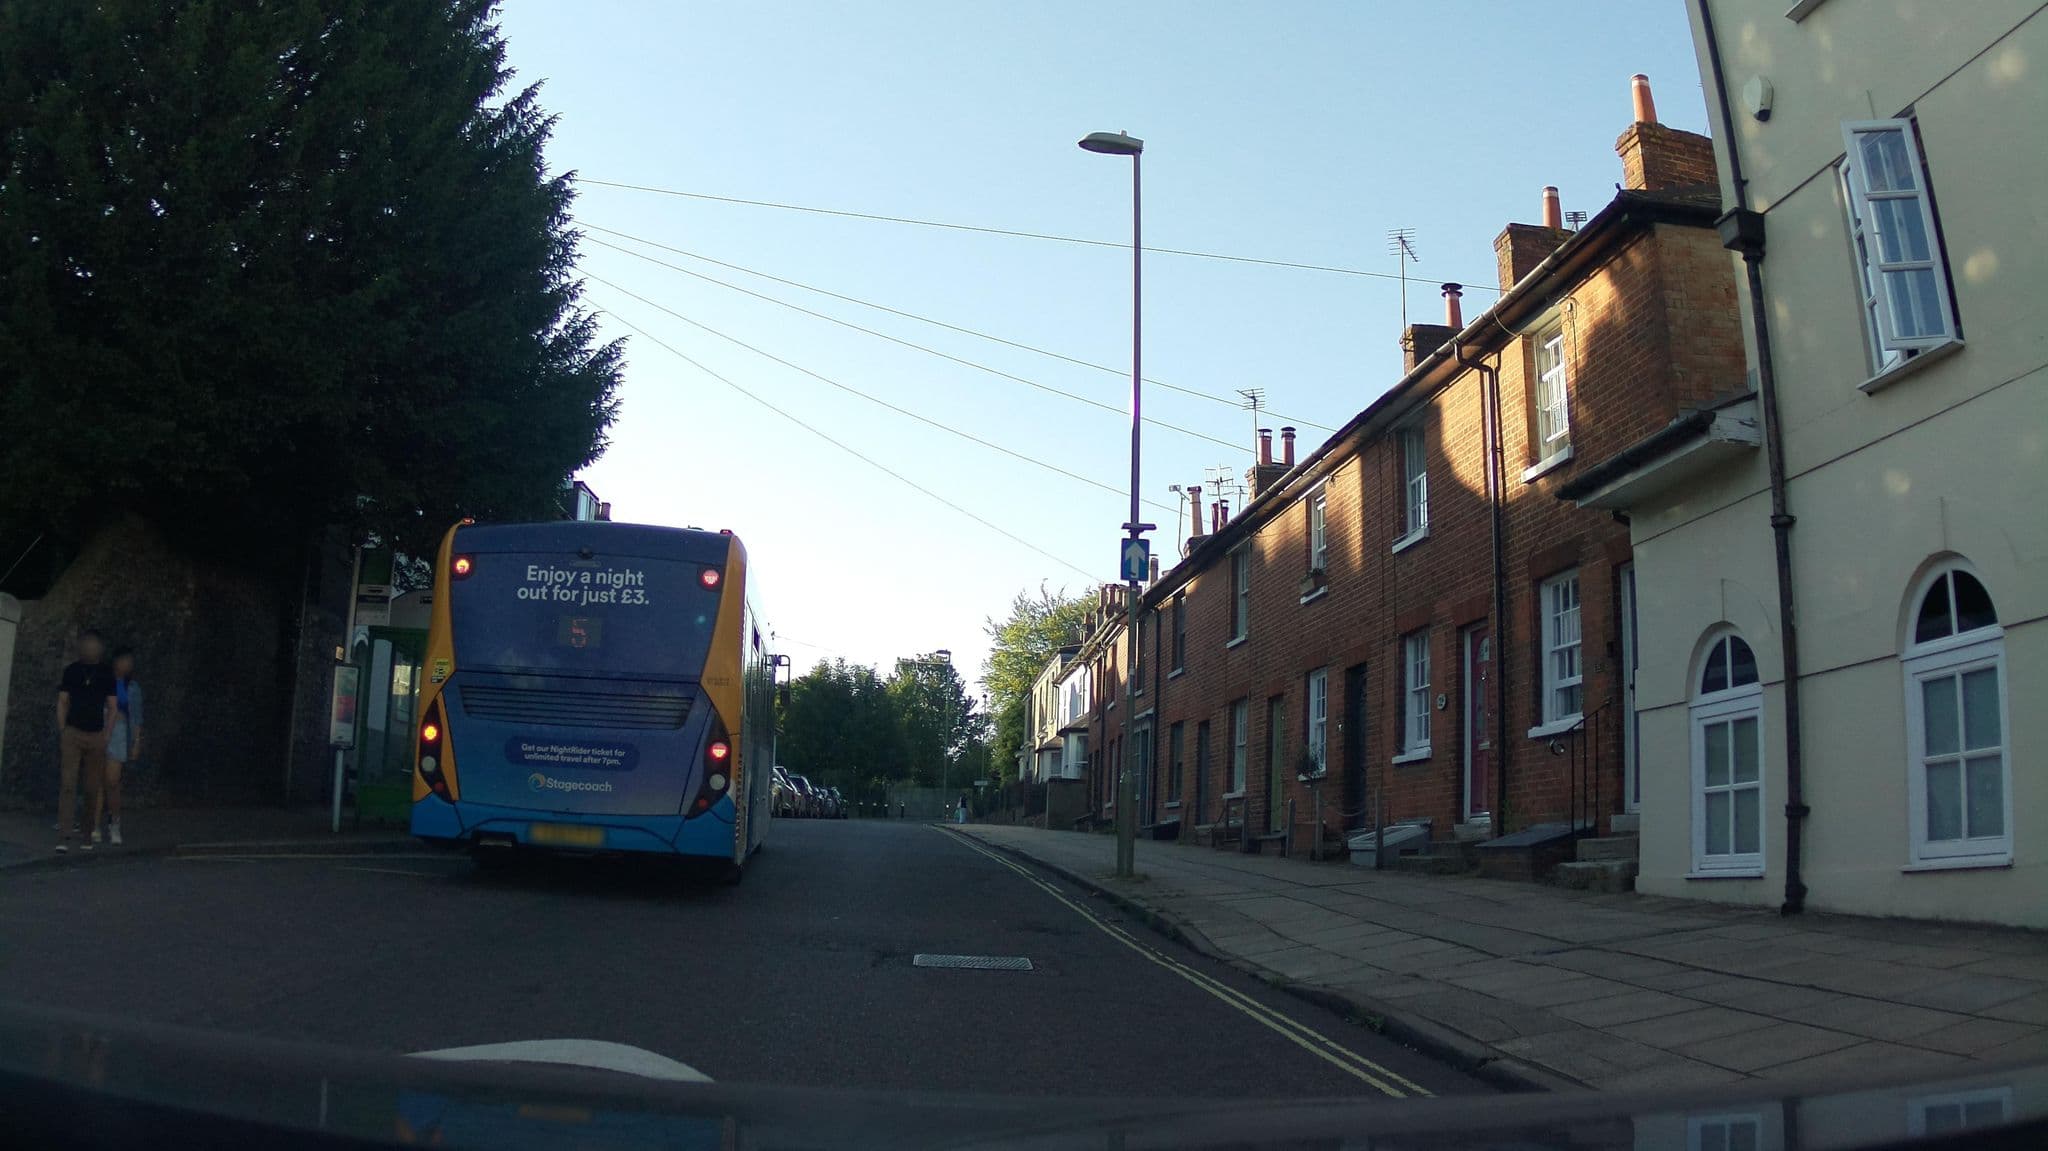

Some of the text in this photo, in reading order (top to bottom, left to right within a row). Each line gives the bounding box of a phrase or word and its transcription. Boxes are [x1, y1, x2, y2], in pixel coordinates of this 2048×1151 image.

[526, 565, 644, 589] Enjoy a night
[517, 585, 650, 606] out for just £3.
[571, 618, 588, 648] 5
[521, 743, 535, 752] Get
[550, 745, 591, 755] NightRider
[591, 748, 613, 756] ticket
[614, 749, 626, 757] for
[524, 752, 621, 767] unlimited travel after 7pm.
[546, 778, 612, 792] Stagecoach
